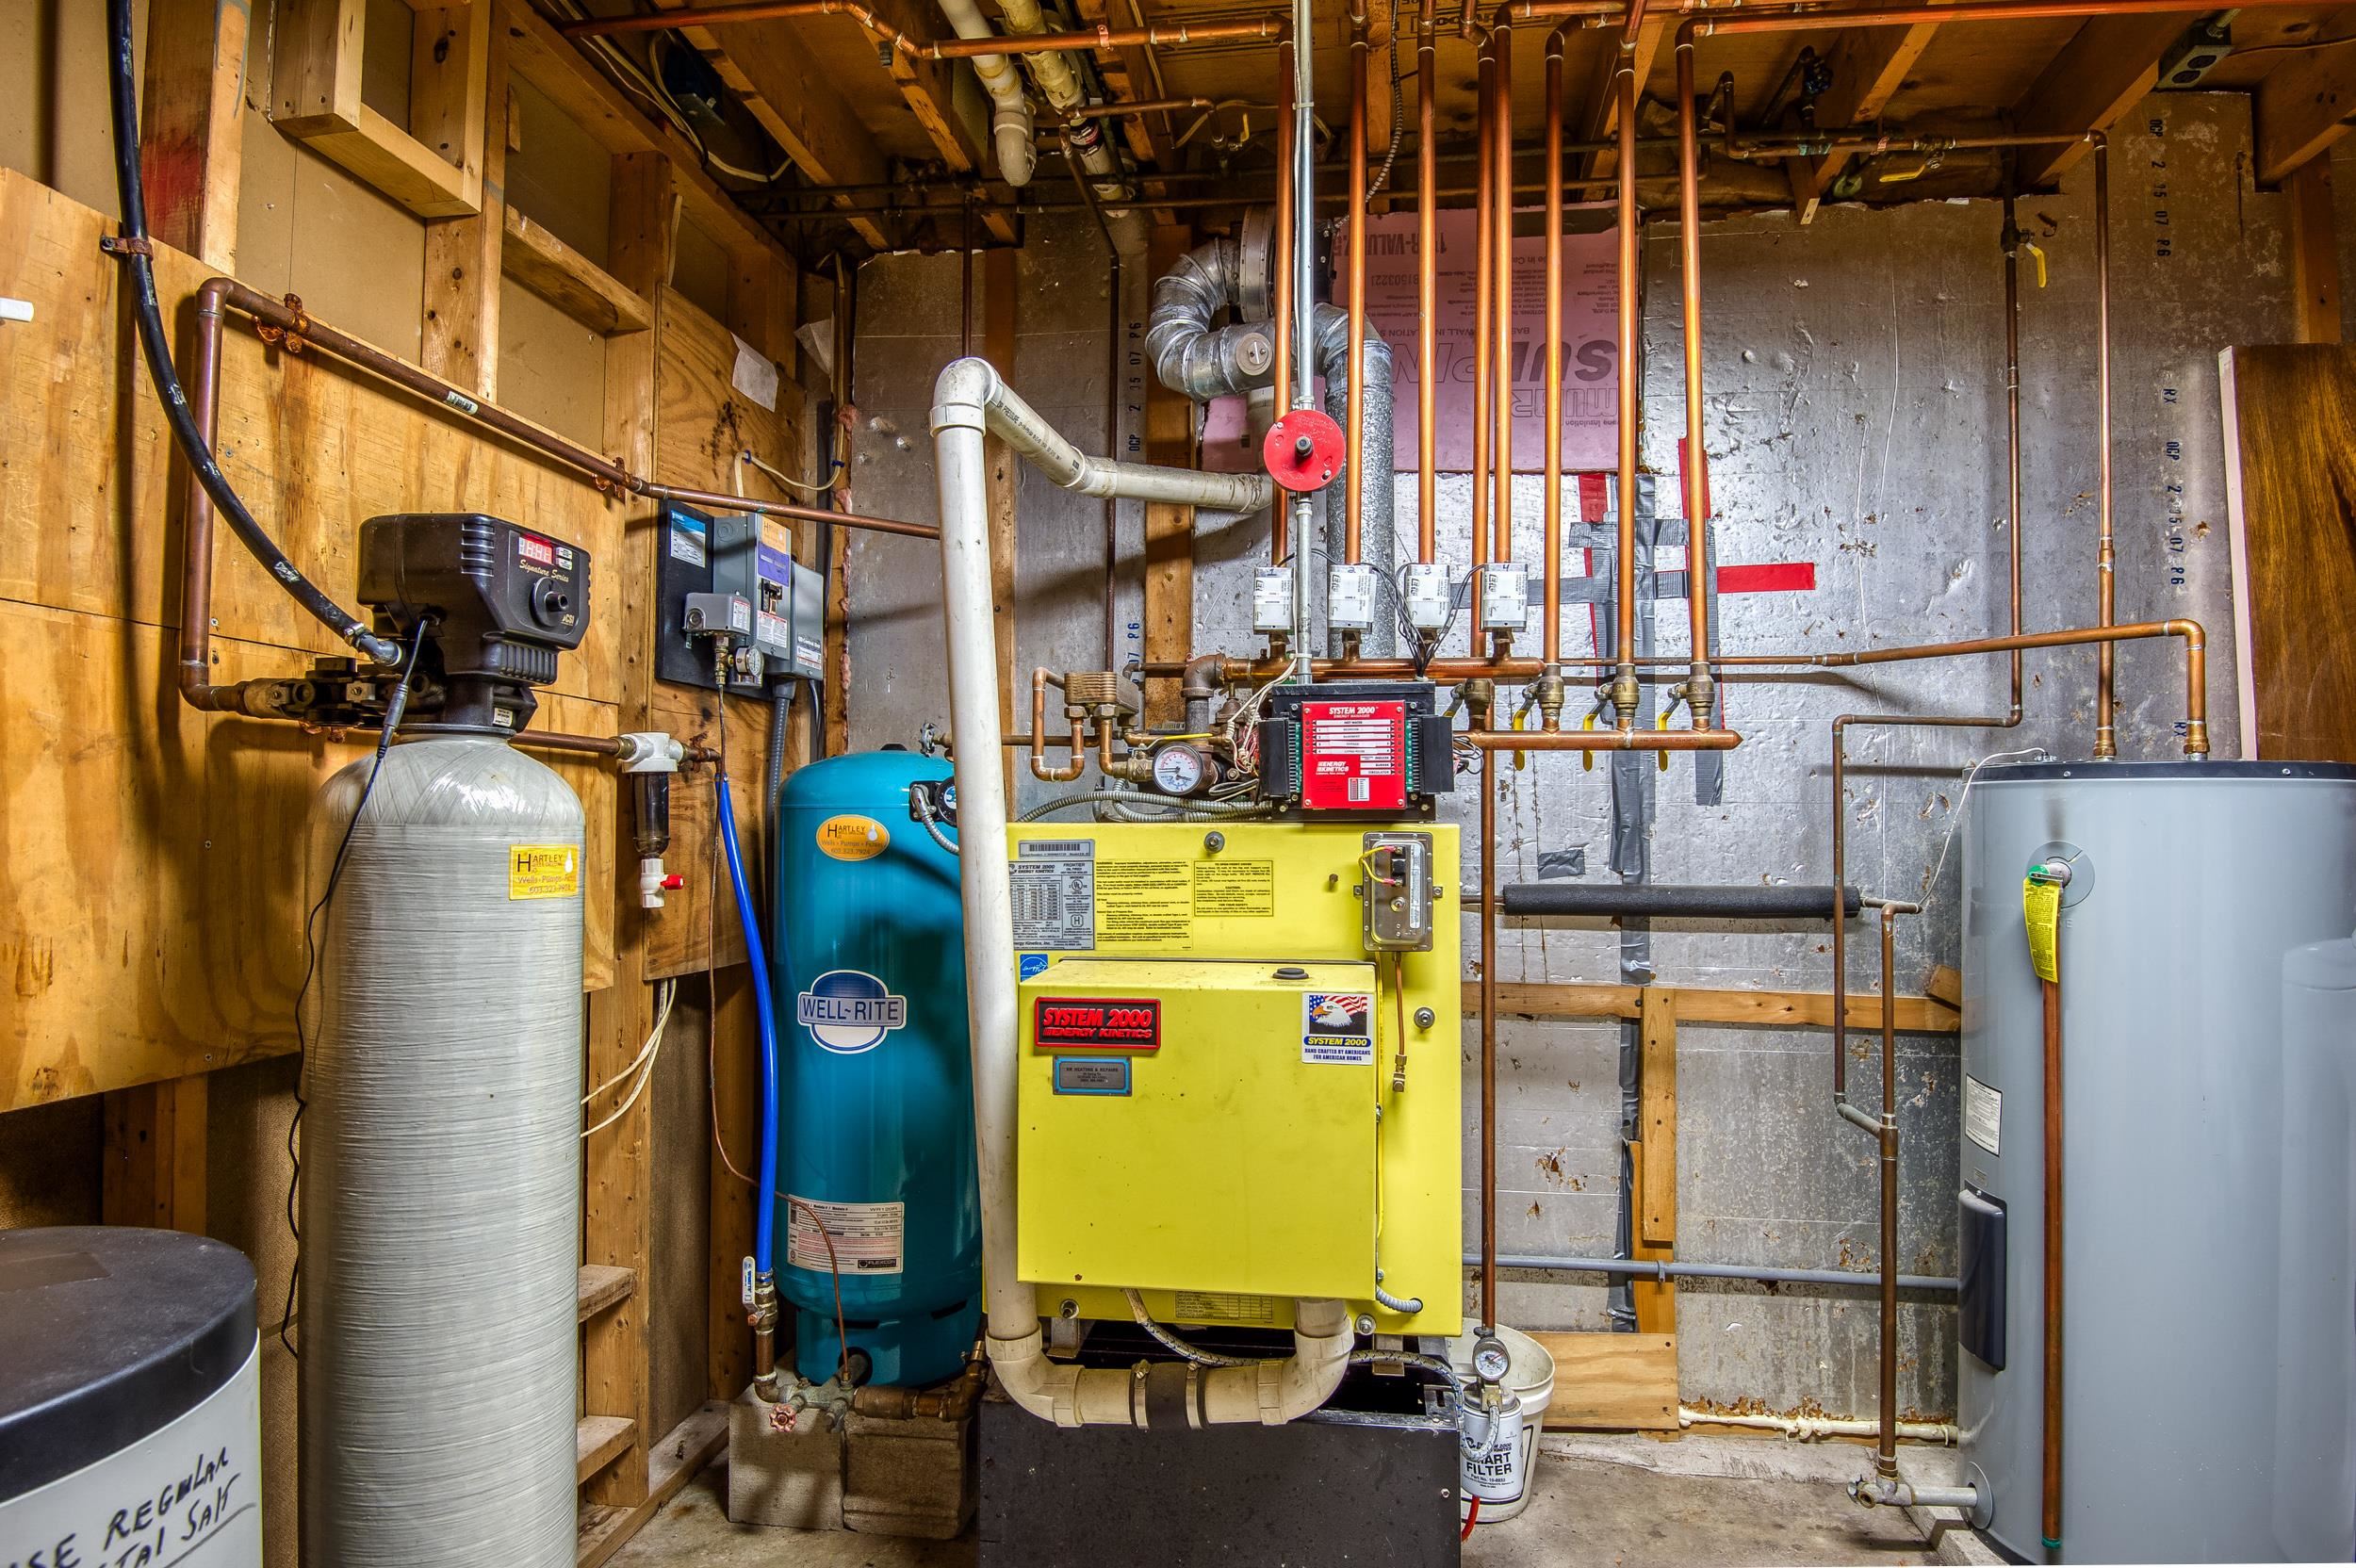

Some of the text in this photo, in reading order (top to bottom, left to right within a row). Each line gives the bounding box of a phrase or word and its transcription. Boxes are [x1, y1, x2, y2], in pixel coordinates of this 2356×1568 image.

[2164, 388, 2177, 404] RX
[2169, 537, 2184, 553] 07
[519, 559, 569, 583] Signature Series
[1425, 565, 1432, 575] 3
[2174, 722, 2186, 738] RX
[827, 824, 865, 838] HARTLEY
[517, 853, 564, 873] HARTLEY
[1074, 916, 1081, 925] H
[1043, 1007, 1153, 1027] SYSTEM 2000
[1047, 1027, 1153, 1038] ENERGY KINETICS
[1478, 1452, 1511, 1464] ART
[1466, 1462, 1512, 1476] FILTER
[8, 1533, 81, 1568] SE
